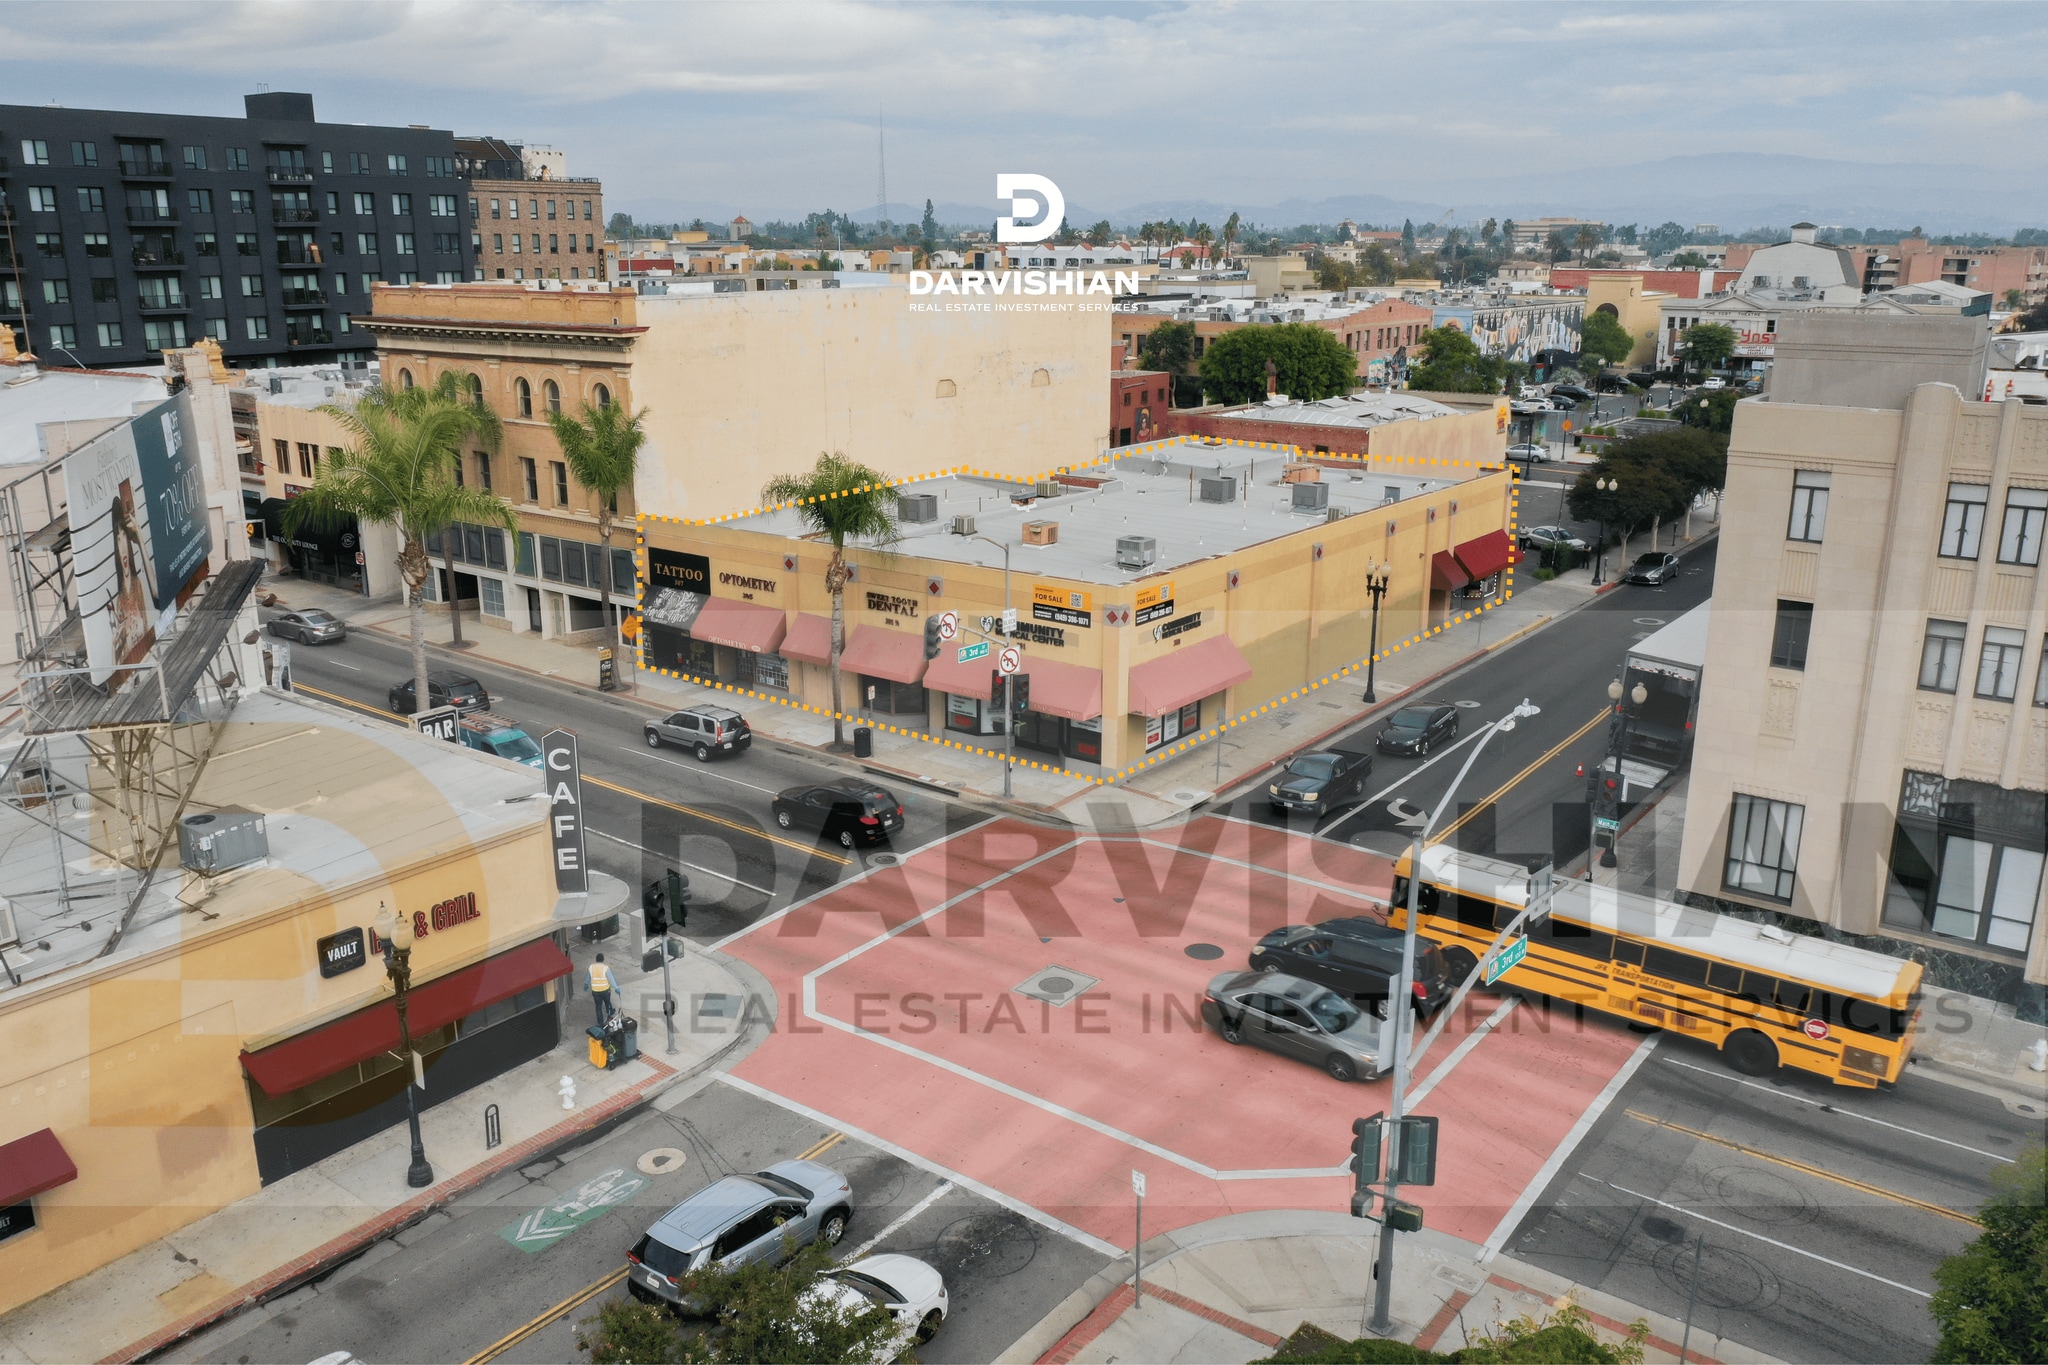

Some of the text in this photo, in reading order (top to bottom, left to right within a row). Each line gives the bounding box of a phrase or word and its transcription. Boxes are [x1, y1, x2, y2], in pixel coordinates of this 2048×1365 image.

[654, 563, 703, 582] TATTOO
[719, 572, 776, 593] OPTOMETRY
[867, 599, 919, 618] DENTAL
[891, 596, 918, 607] TOOTH
[1048, 595, 1063, 604] SALE
[708, 636, 747, 649] OPTOMETRY
[1032, 634, 1065, 648] CENTER
[968, 647, 979, 657] 3rd
[422, 719, 455, 739] BAR
[547, 748, 579, 871] CAFE
[431, 891, 481, 933] GRILL
[327, 941, 358, 963] VAULT
[1501, 951, 1513, 969] 3rd
[1594, 963, 1676, 990] JFK TRANSPORTATION
[1807, 1023, 1826, 1035] STOP
